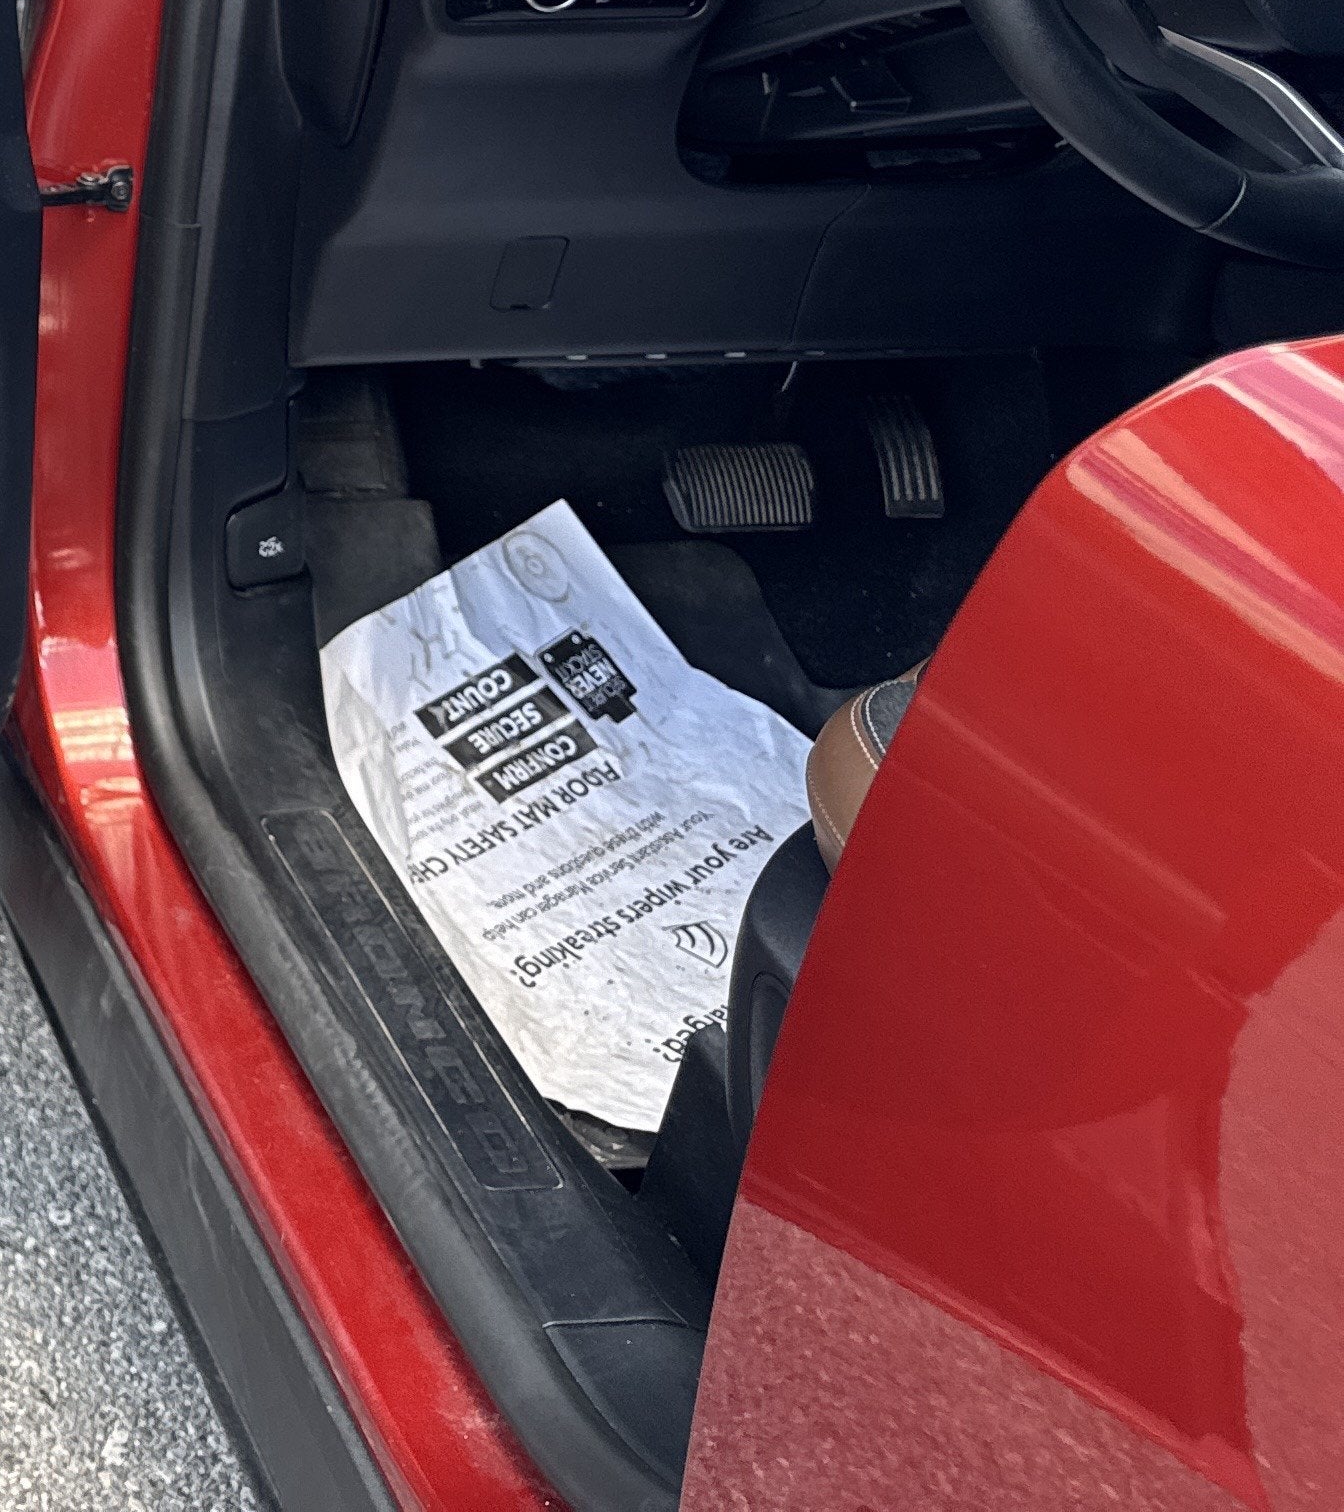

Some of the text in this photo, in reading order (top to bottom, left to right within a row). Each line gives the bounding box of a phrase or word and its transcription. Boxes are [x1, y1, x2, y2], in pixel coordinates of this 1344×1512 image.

[443, 668, 513, 723] COUNT
[565, 657, 618, 700] NEVER
[468, 702, 545, 755] SECURE
[492, 734, 577, 791] CONFIRM
[551, 759, 622, 807] FLOOR
[516, 793, 561, 832] MAT
[443, 819, 519, 866] SAFETY
[549, 842, 608, 880] questions
[522, 874, 552, 898] and
[544, 876, 594, 908] Manager
[585, 854, 636, 886] Service
[510, 824, 774, 988] Are your wipers streaking?
[481, 917, 520, 942] help
[652, 1003, 728, 1063] arged?
